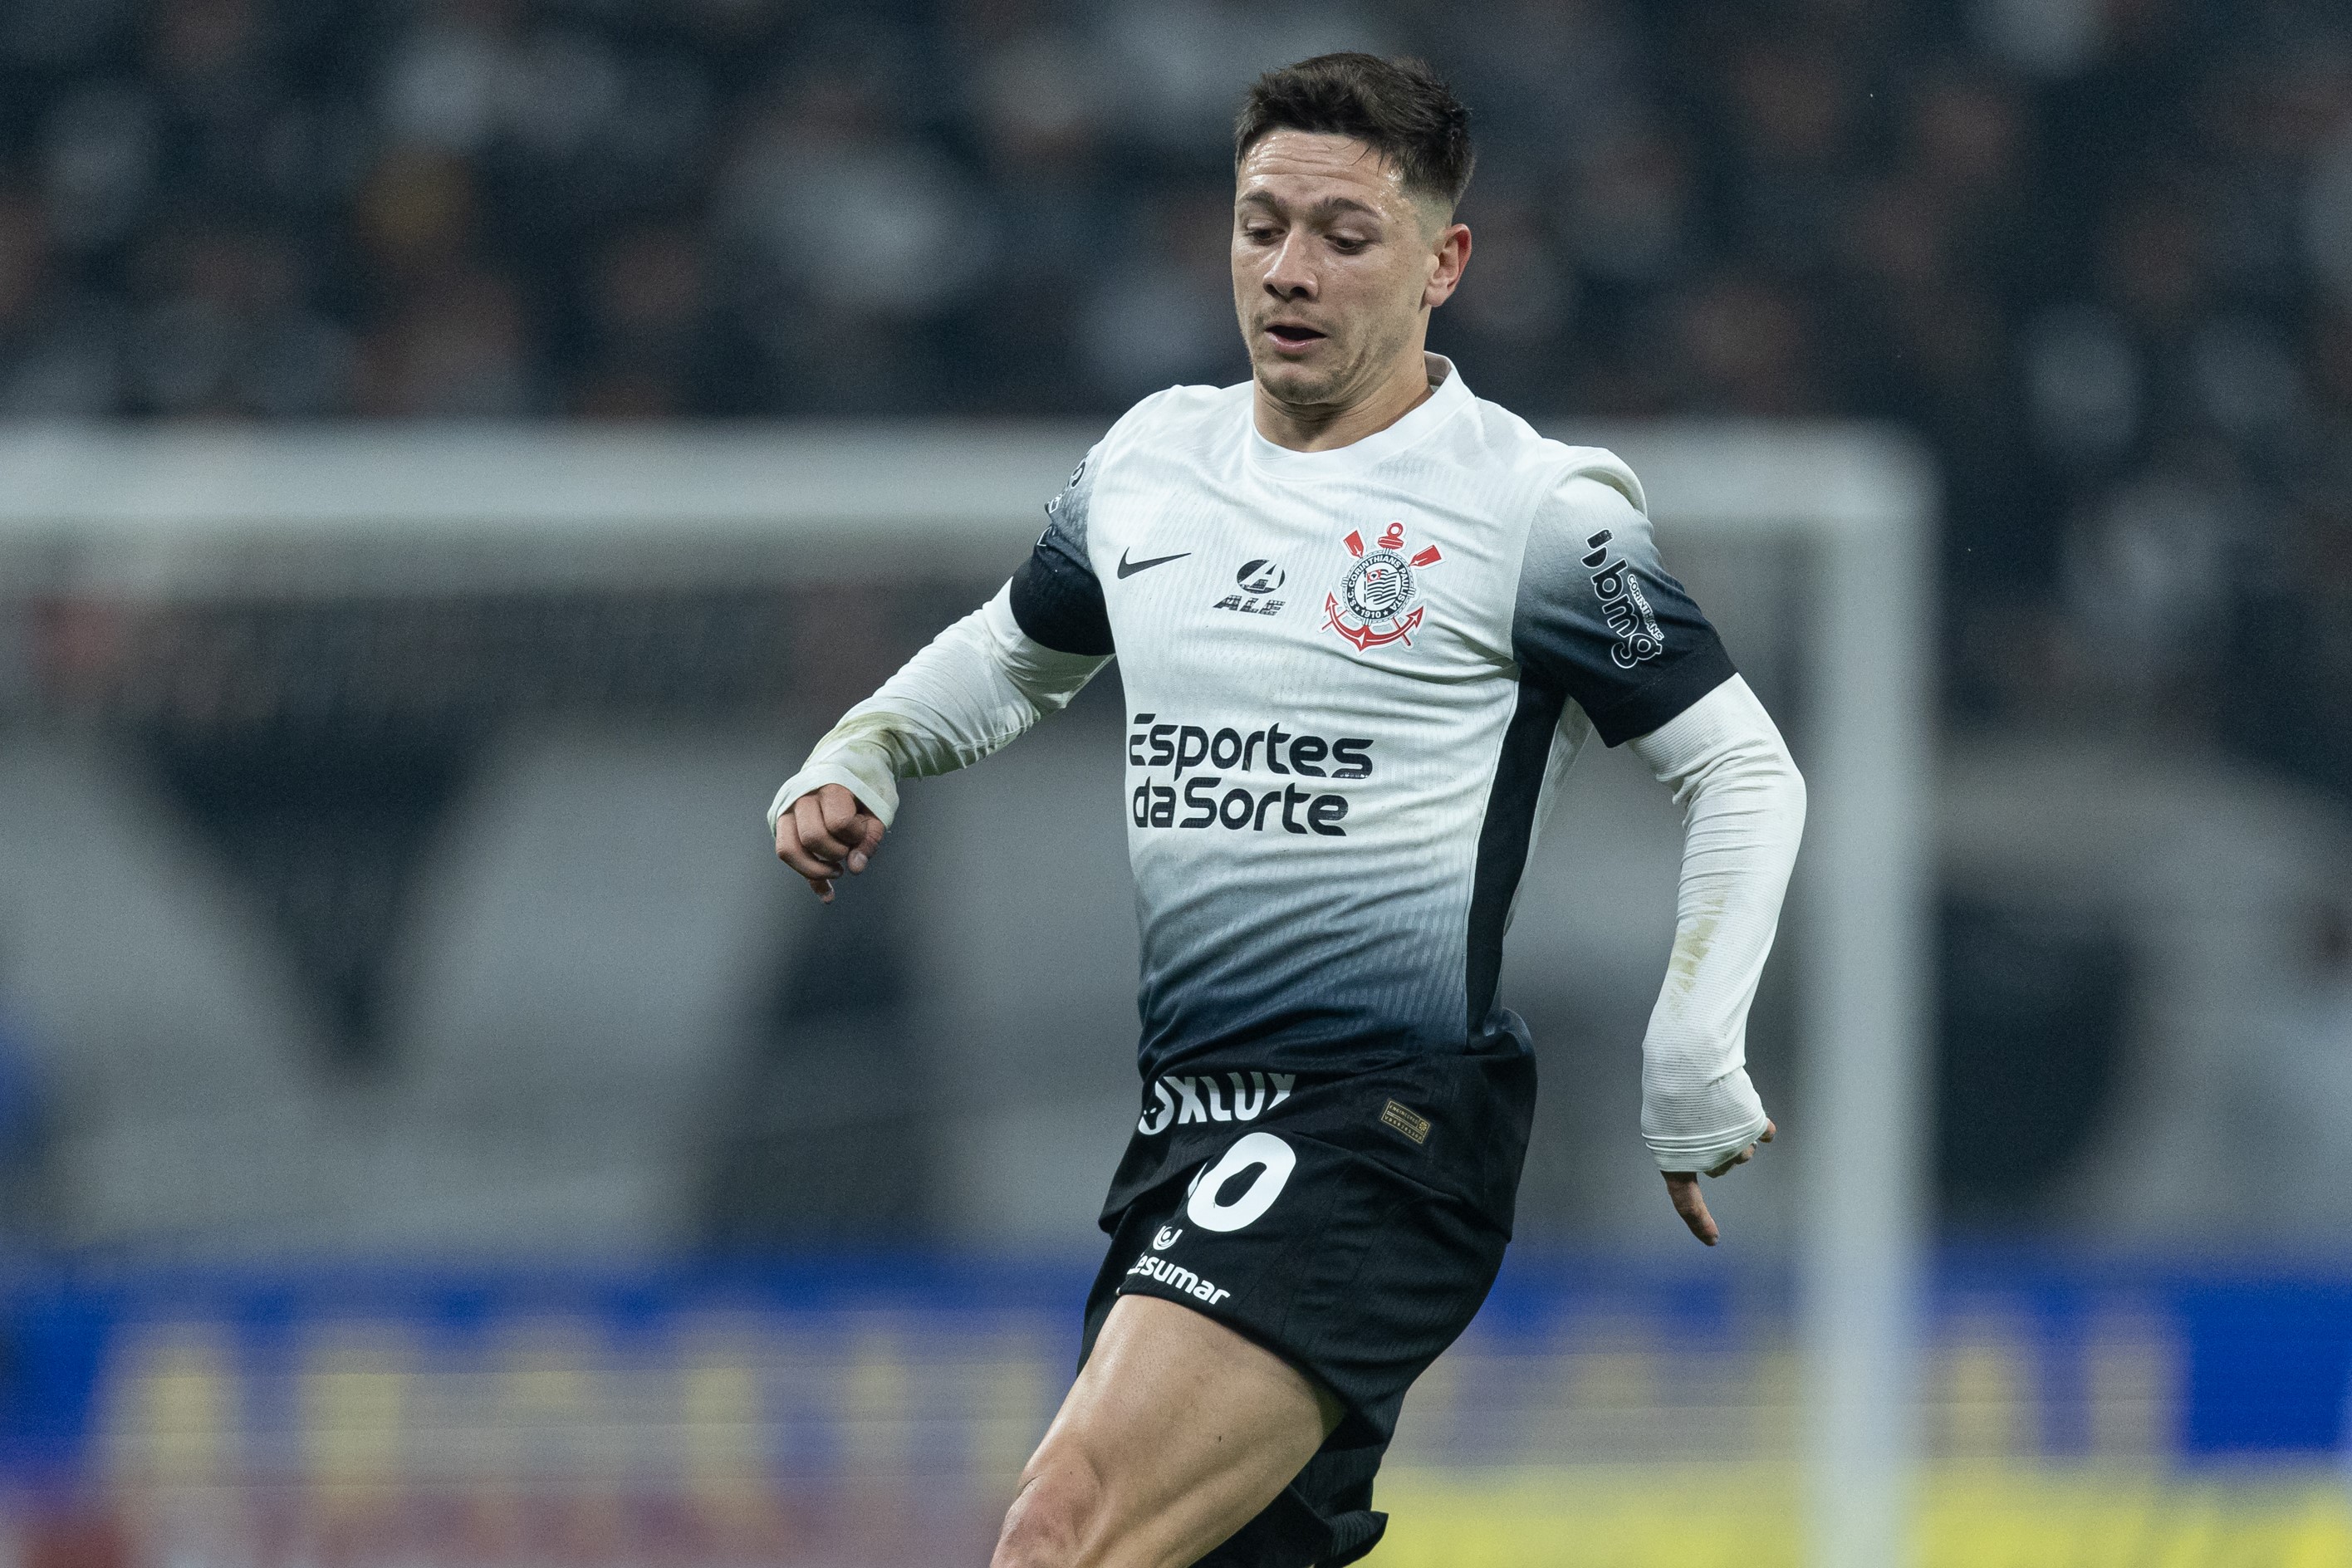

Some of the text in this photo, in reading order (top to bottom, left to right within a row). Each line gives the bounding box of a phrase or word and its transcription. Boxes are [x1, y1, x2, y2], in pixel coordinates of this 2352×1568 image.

[1213, 594, 1286, 616] ALE
[1360, 609, 1381, 618] 1910
[1389, 567, 1409, 611] PAULISTA
[1627, 574, 1664, 641] CORINTHIANS
[1129, 713, 1374, 782] Esportes
[1179, 777, 1349, 836] Sorte
[1187, 1131, 1296, 1232] 0
